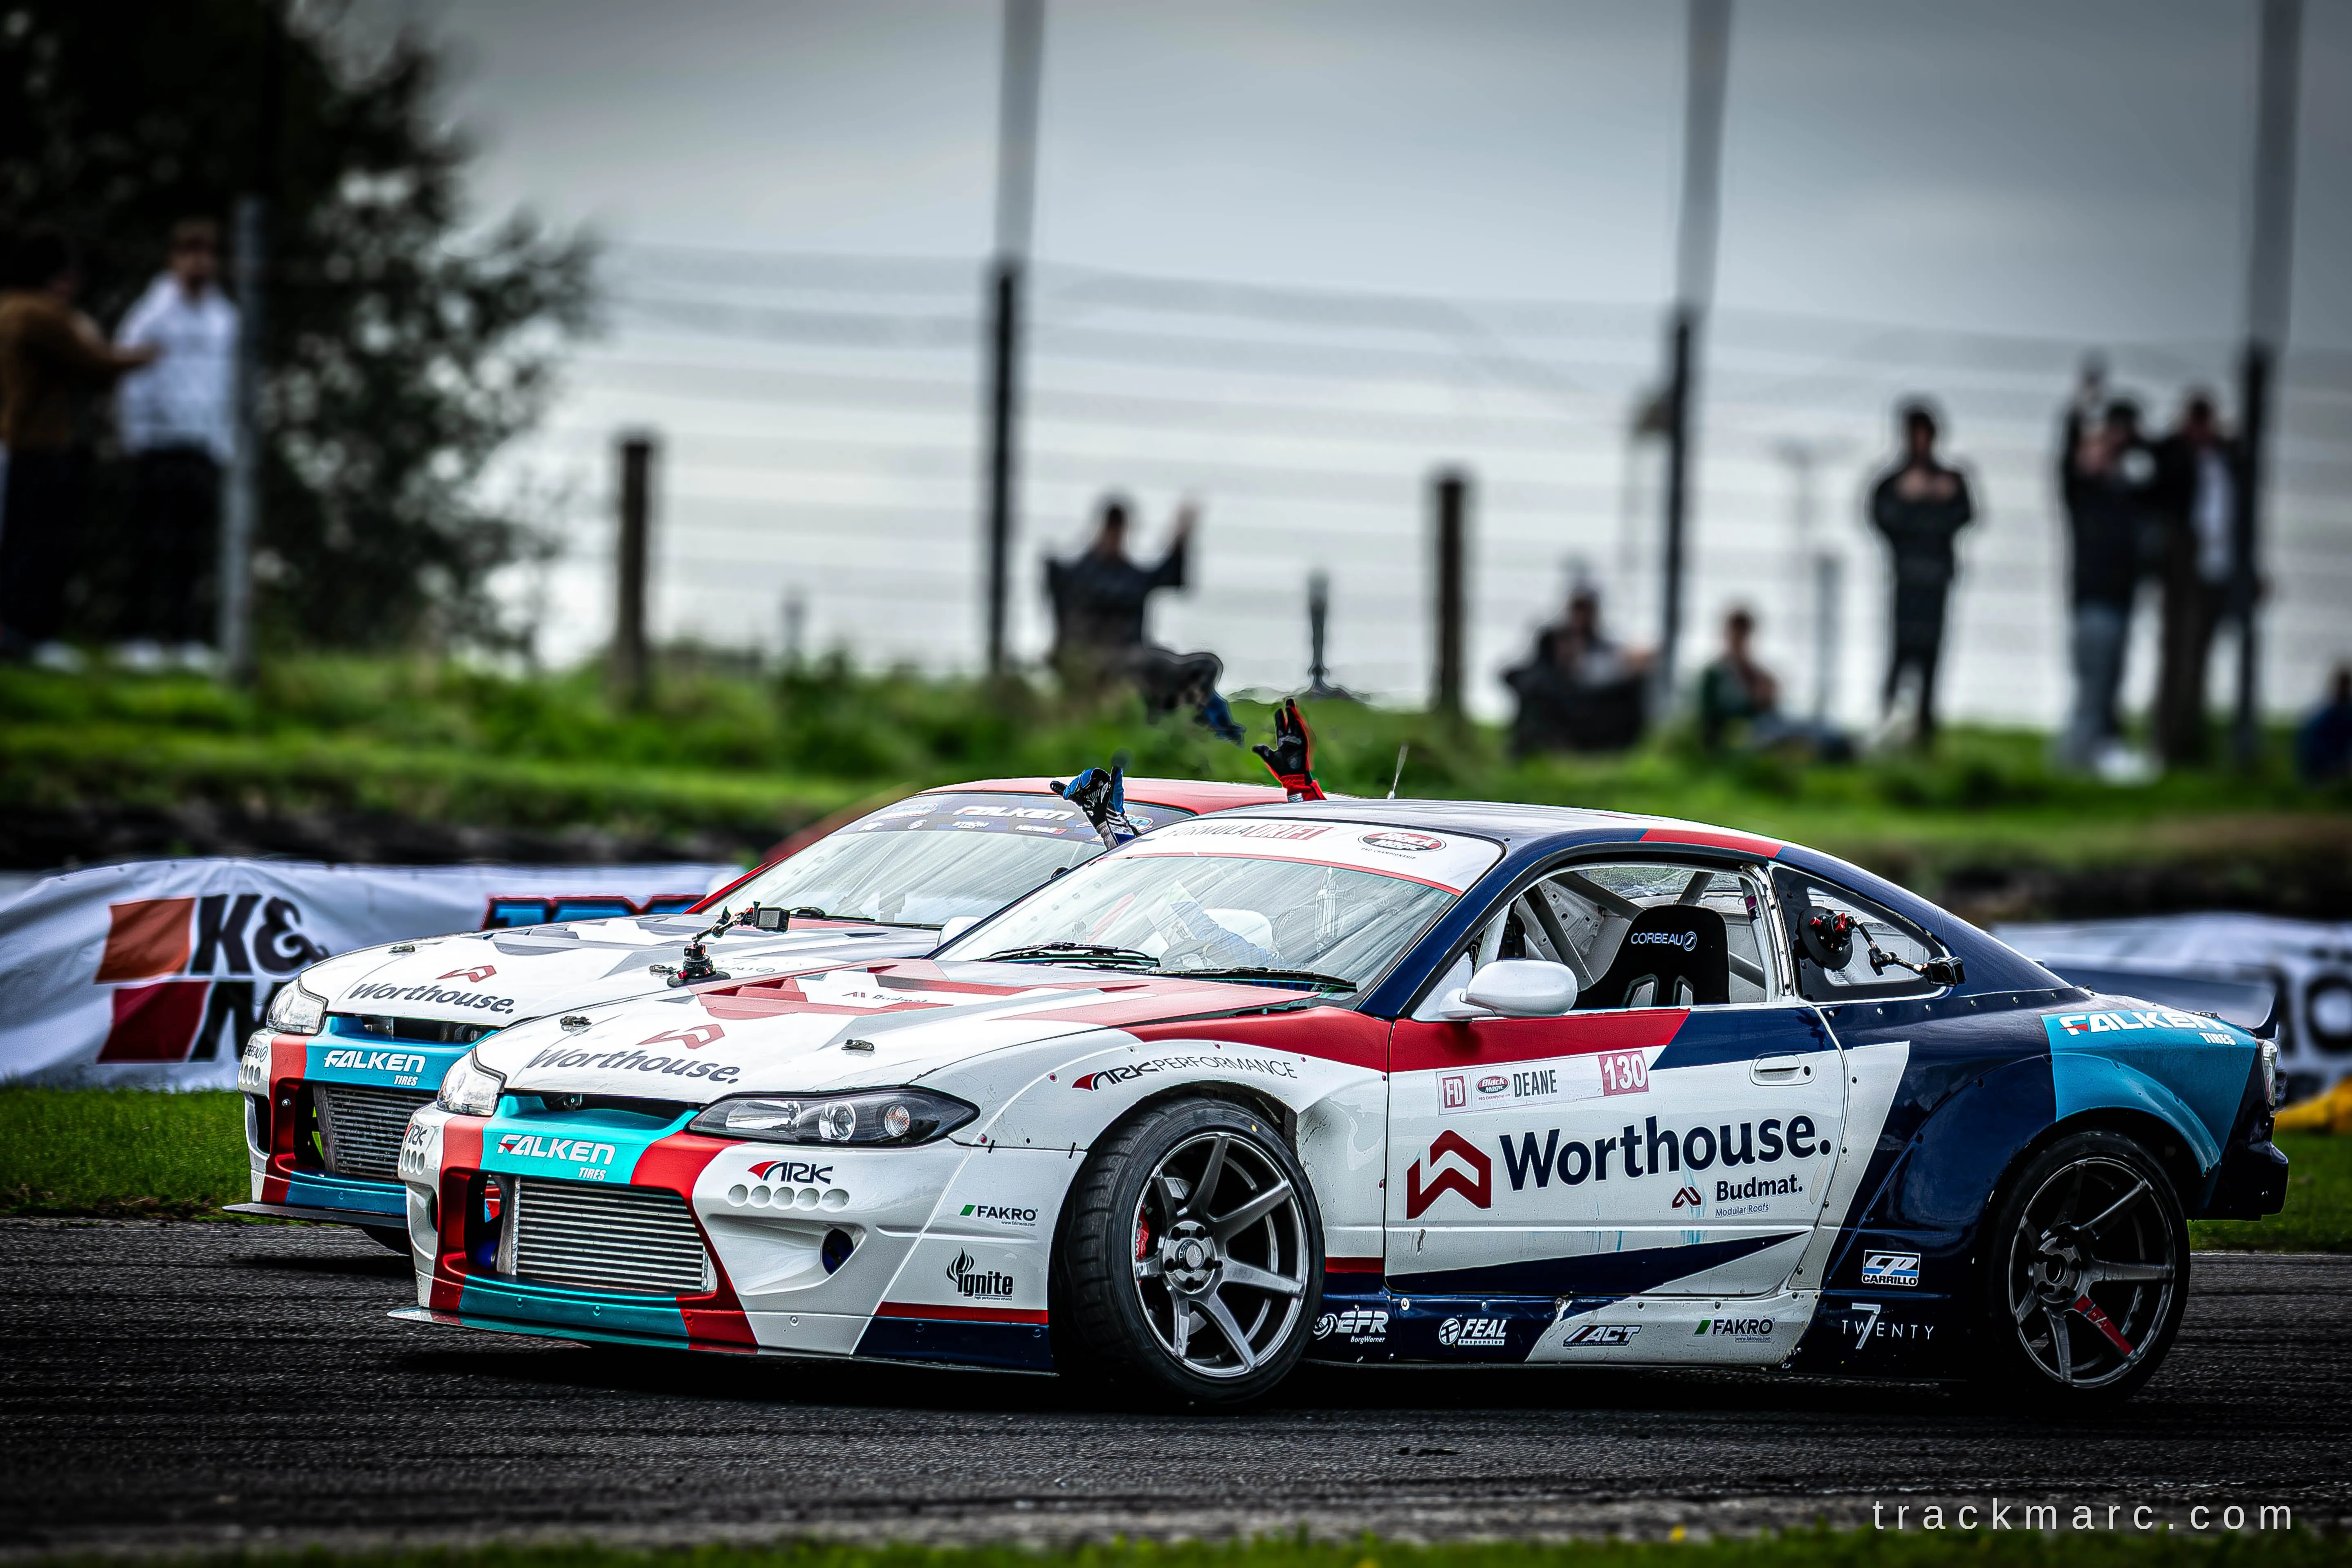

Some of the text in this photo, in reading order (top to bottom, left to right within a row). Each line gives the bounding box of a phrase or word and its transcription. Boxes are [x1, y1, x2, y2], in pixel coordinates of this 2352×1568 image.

[952, 806, 1075, 821] FALKEN
[1248, 824, 1332, 840] DRIFT
[1631, 933, 1683, 946] CORBEAU
[348, 983, 514, 1014] Worthouse.
[2059, 1011, 2224, 1036] FALKEN
[2199, 1032, 2236, 1045] TIRES
[323, 1050, 426, 1073] FALKEN
[526, 1049, 741, 1084] Worthouse.
[1603, 1051, 1646, 1091] 130
[393, 1075, 418, 1086] TIRES
[1481, 1077, 1505, 1087] Black
[1514, 1070, 1558, 1097] DEANE
[1445, 1078, 1463, 1106] FD
[497, 1134, 616, 1165] FALKEN
[1499, 1115, 1831, 1191] Worthouse.
[578, 1167, 606, 1180] TIRES
[747, 1160, 834, 1185] ARK
[1716, 1173, 1803, 1202] Budmat.
[1716, 1202, 1769, 1217] Modular Roofs
[957, 1269, 1014, 1297] ignite
[1862, 1274, 1917, 1285] CARRILLO
[1335, 1311, 1389, 1333] EFR
[1460, 1319, 1507, 1337] FEAL
[1350, 1336, 1385, 1344] BorgWarner
[1580, 1326, 1641, 1342] ACT
